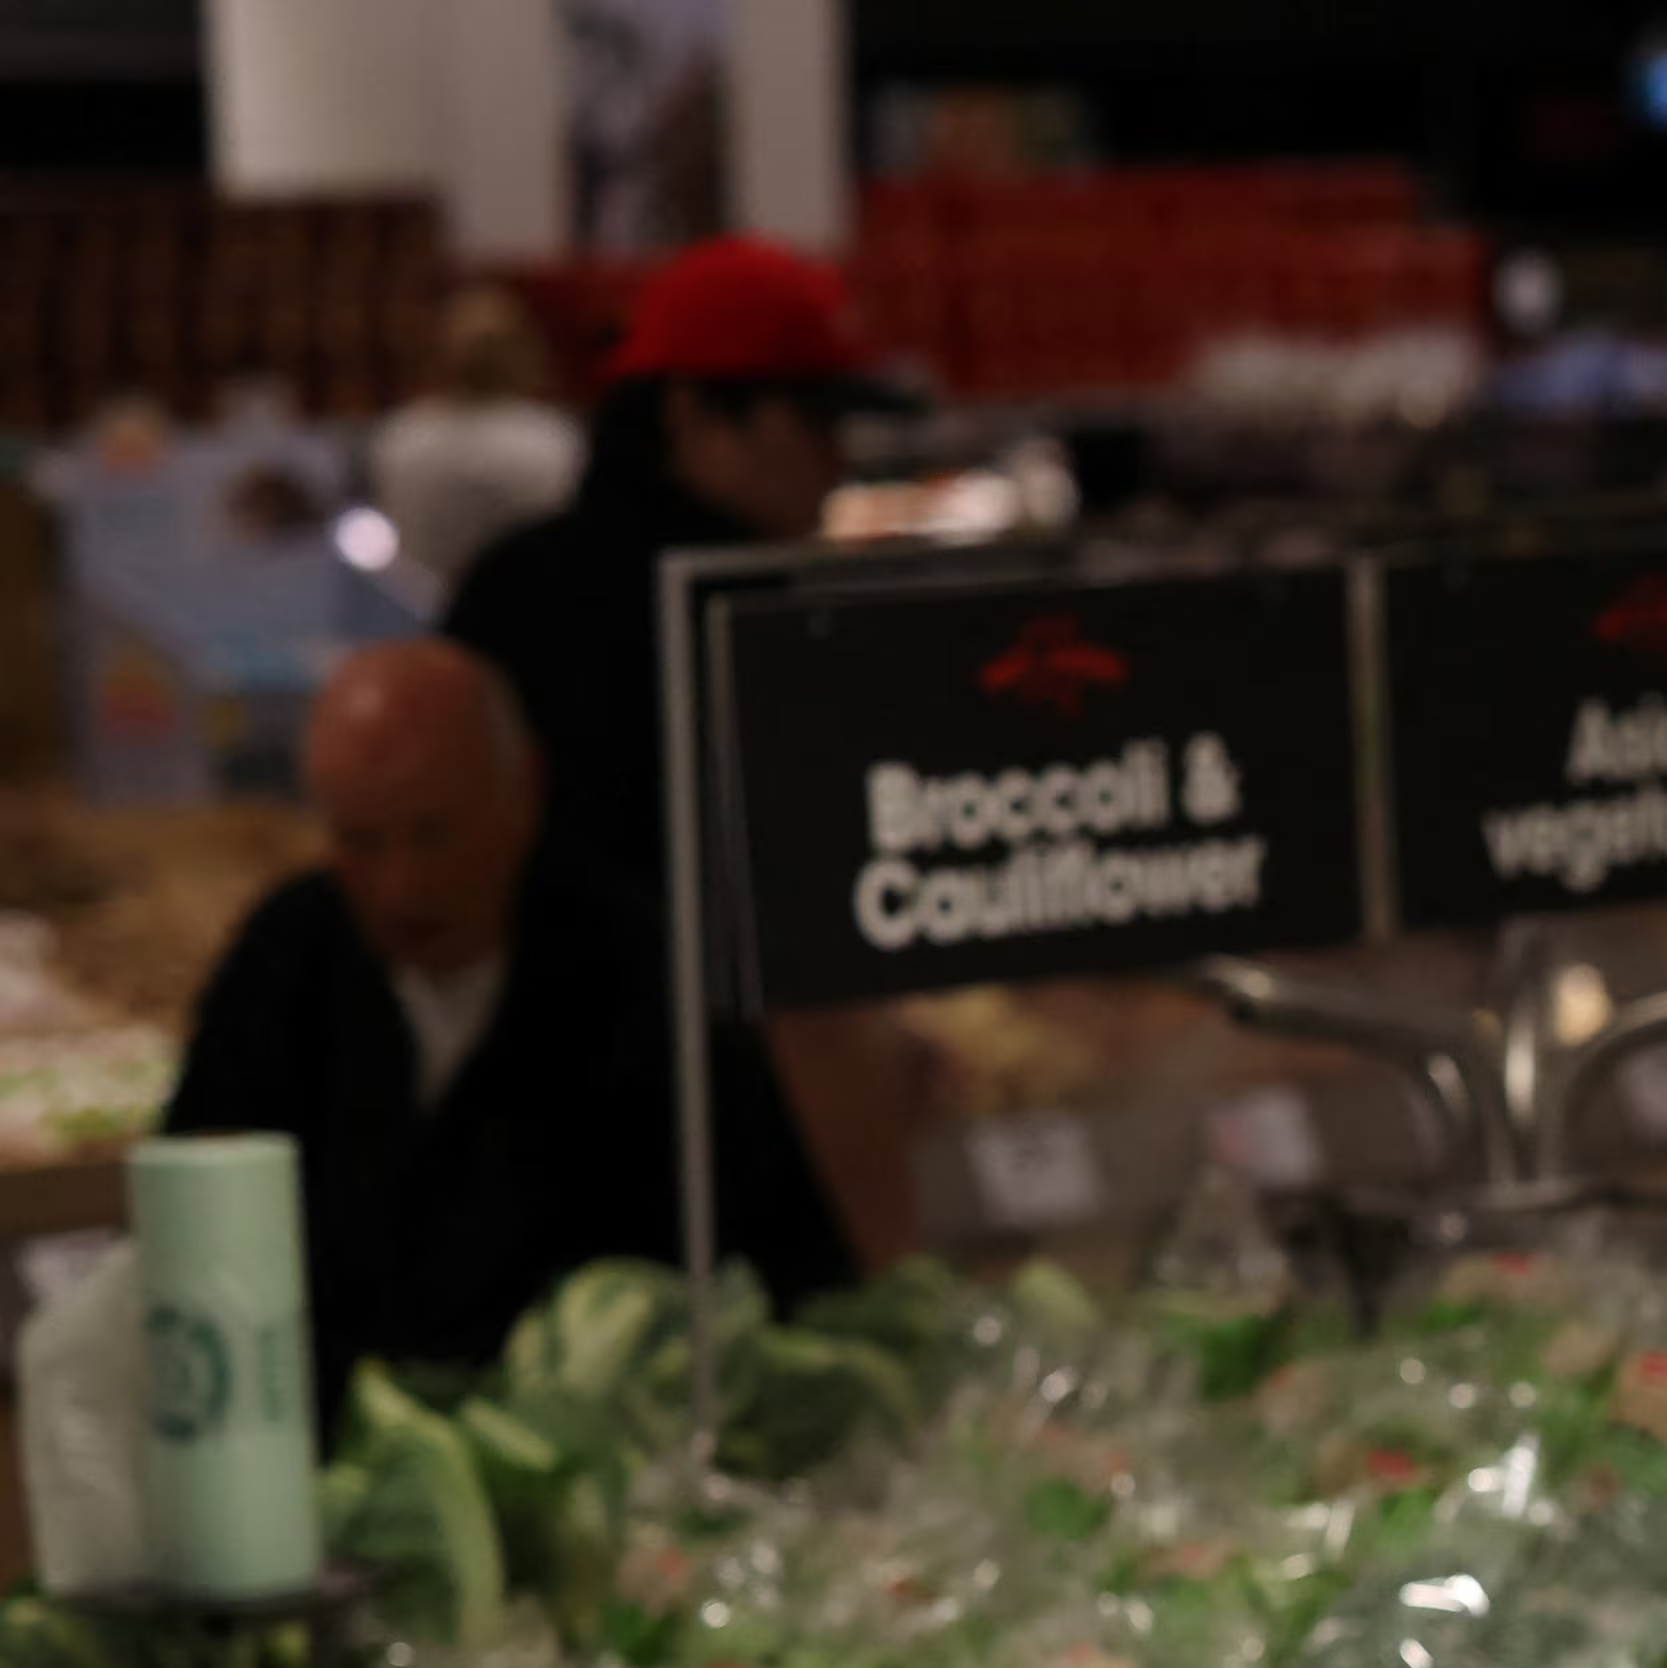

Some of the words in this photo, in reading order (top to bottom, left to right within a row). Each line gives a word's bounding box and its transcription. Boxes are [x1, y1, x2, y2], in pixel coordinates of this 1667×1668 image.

[869, 742, 1168, 850] Broccoli
[1183, 730, 1242, 826] &
[854, 835, 1264, 952] Cauliflower
